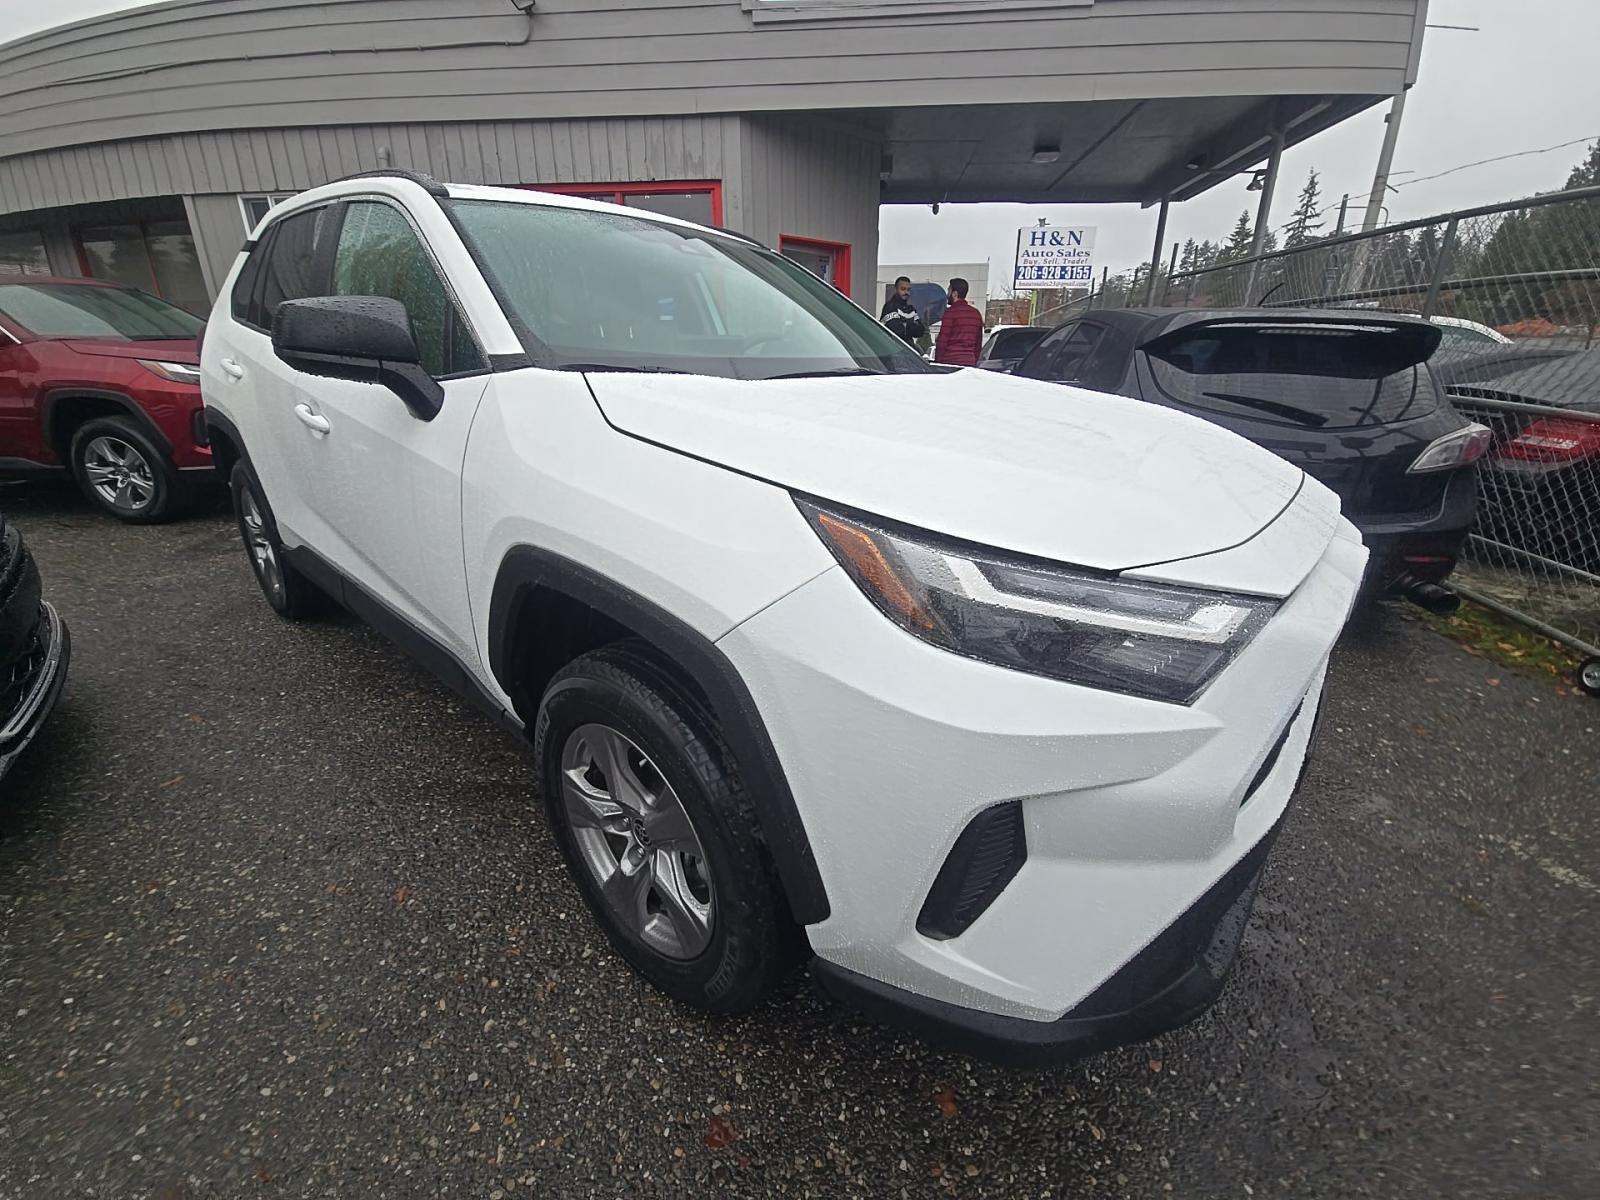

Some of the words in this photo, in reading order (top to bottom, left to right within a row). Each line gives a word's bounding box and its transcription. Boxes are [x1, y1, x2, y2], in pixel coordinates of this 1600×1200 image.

[1021, 249, 1054, 257] Auto
[1056, 248, 1091, 257] Sales
[1018, 266, 1090, 279] 206-928-3155
